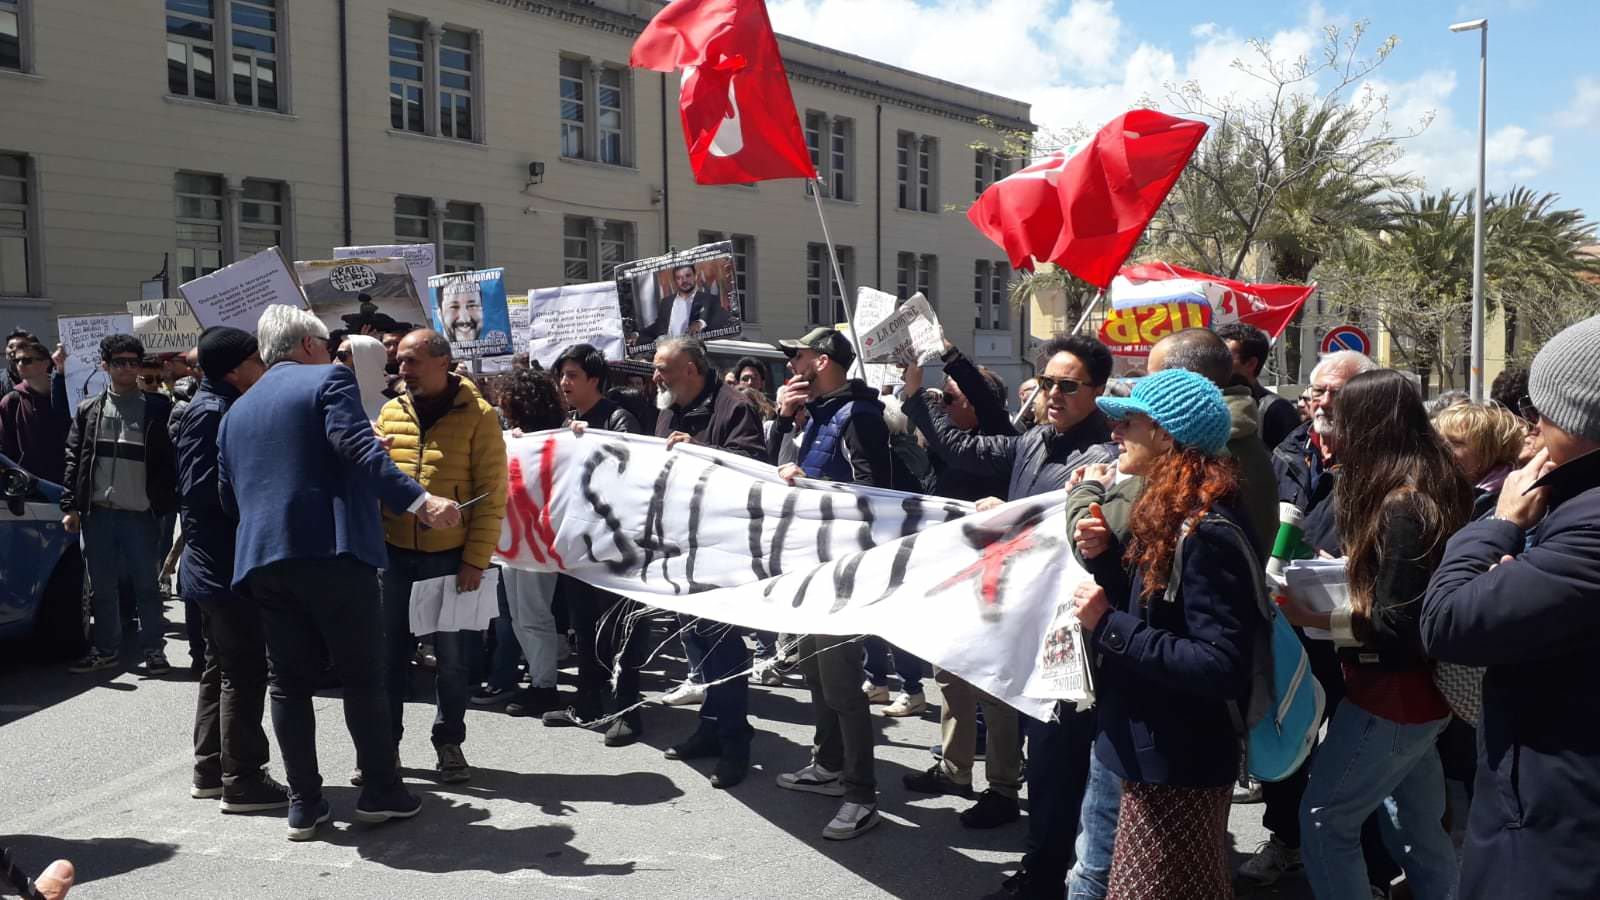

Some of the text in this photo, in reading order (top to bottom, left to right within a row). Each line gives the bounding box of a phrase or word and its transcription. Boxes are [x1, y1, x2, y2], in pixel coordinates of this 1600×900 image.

[140, 302, 154, 317] MA
[160, 301, 168, 316] AL
[158, 318, 177, 331] NON
[877, 328, 888, 342] LA
